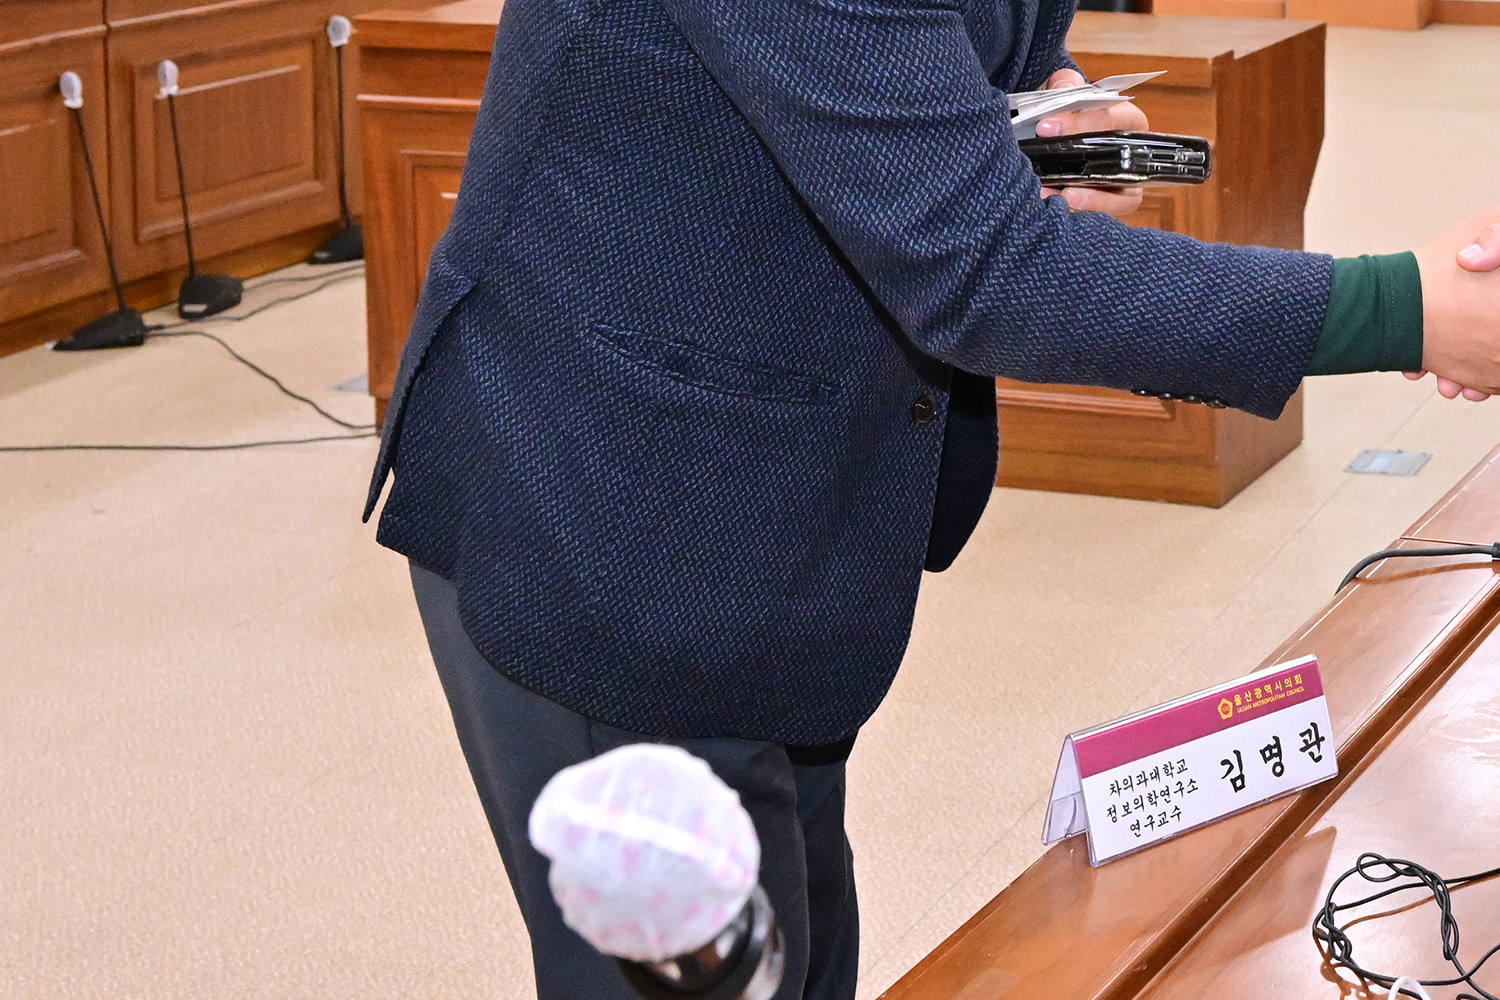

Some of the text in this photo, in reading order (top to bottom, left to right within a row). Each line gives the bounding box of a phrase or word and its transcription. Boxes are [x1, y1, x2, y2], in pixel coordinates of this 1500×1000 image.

[1233, 673, 1303, 706] 울산광역시의회
[1237, 686, 1305, 714] ULSAN METROPOLITAN COUNCIL
[1109, 758, 1188, 798] 차의과대학교
[1106, 778, 1199, 823] 정보의학연구소
[1129, 805, 1182, 838] 연구교수
